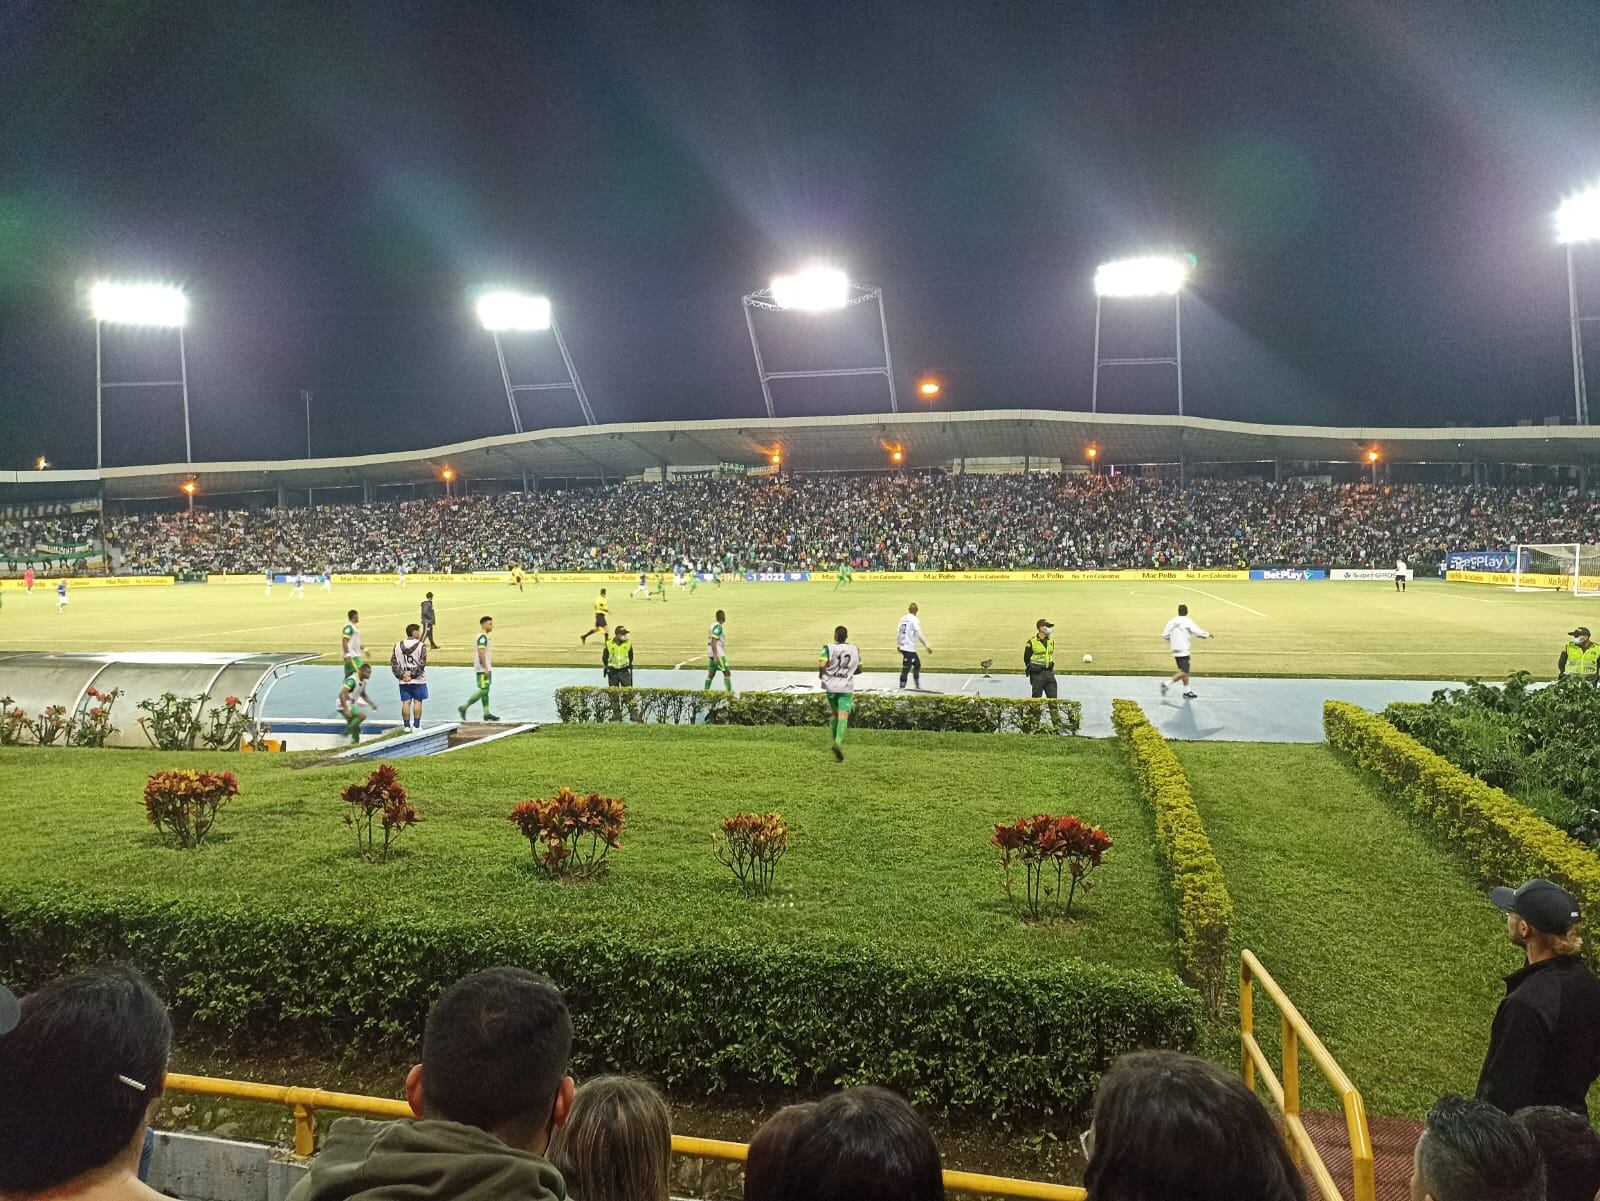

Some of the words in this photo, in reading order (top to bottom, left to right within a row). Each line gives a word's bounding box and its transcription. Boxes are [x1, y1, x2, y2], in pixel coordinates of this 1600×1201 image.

[760, 573, 785, 581] 2022
[1263, 568, 1303, 581] BetPlay
[836, 654, 852, 669] 12
